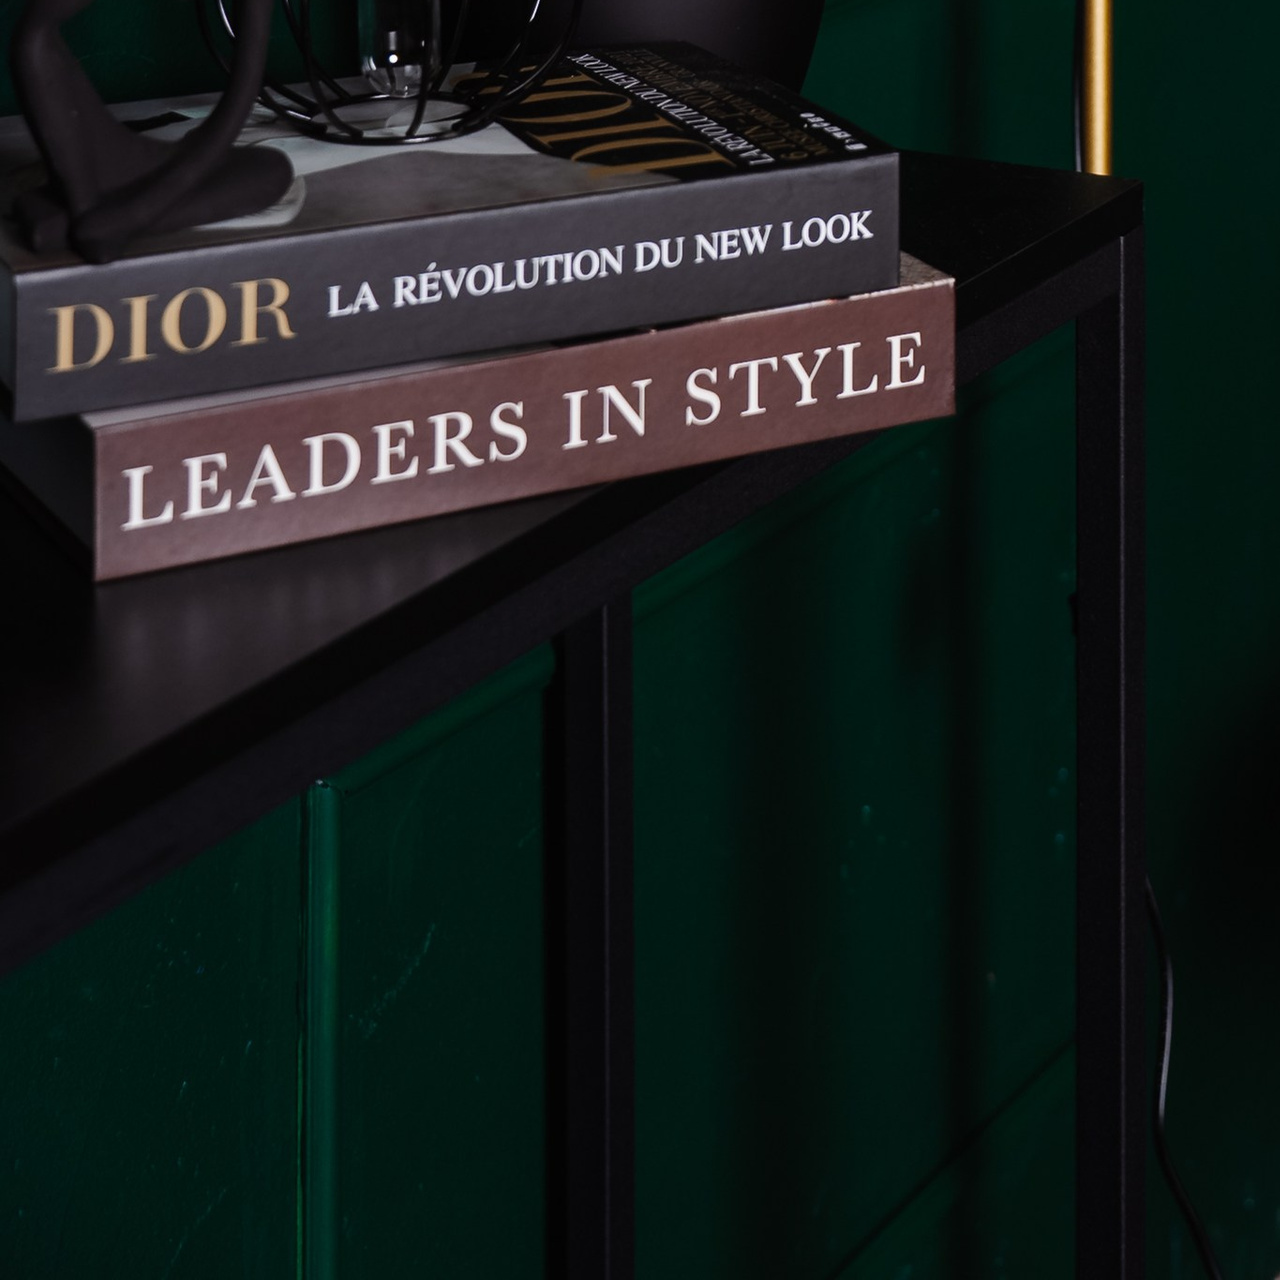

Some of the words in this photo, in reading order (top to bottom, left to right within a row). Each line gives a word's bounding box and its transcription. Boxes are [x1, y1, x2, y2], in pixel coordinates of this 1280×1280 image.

[566, 54, 617, 73] LOOK
[599, 72, 648, 89] NEW
[629, 88, 667, 100] DU
[650, 99, 754, 151] RÉVOLUTION
[739, 149, 775, 165] LA
[46, 277, 298, 374] DIOR
[326, 281, 380, 318] LA
[393, 244, 626, 308] RÉVOLUTION
[634, 236, 686, 273] DU
[694, 223, 774, 264] NEW
[781, 209, 874, 252] LOOK
[121, 401, 528, 532] LEADERS
[562, 378, 653, 450] IN
[685, 331, 926, 426] STYLE
